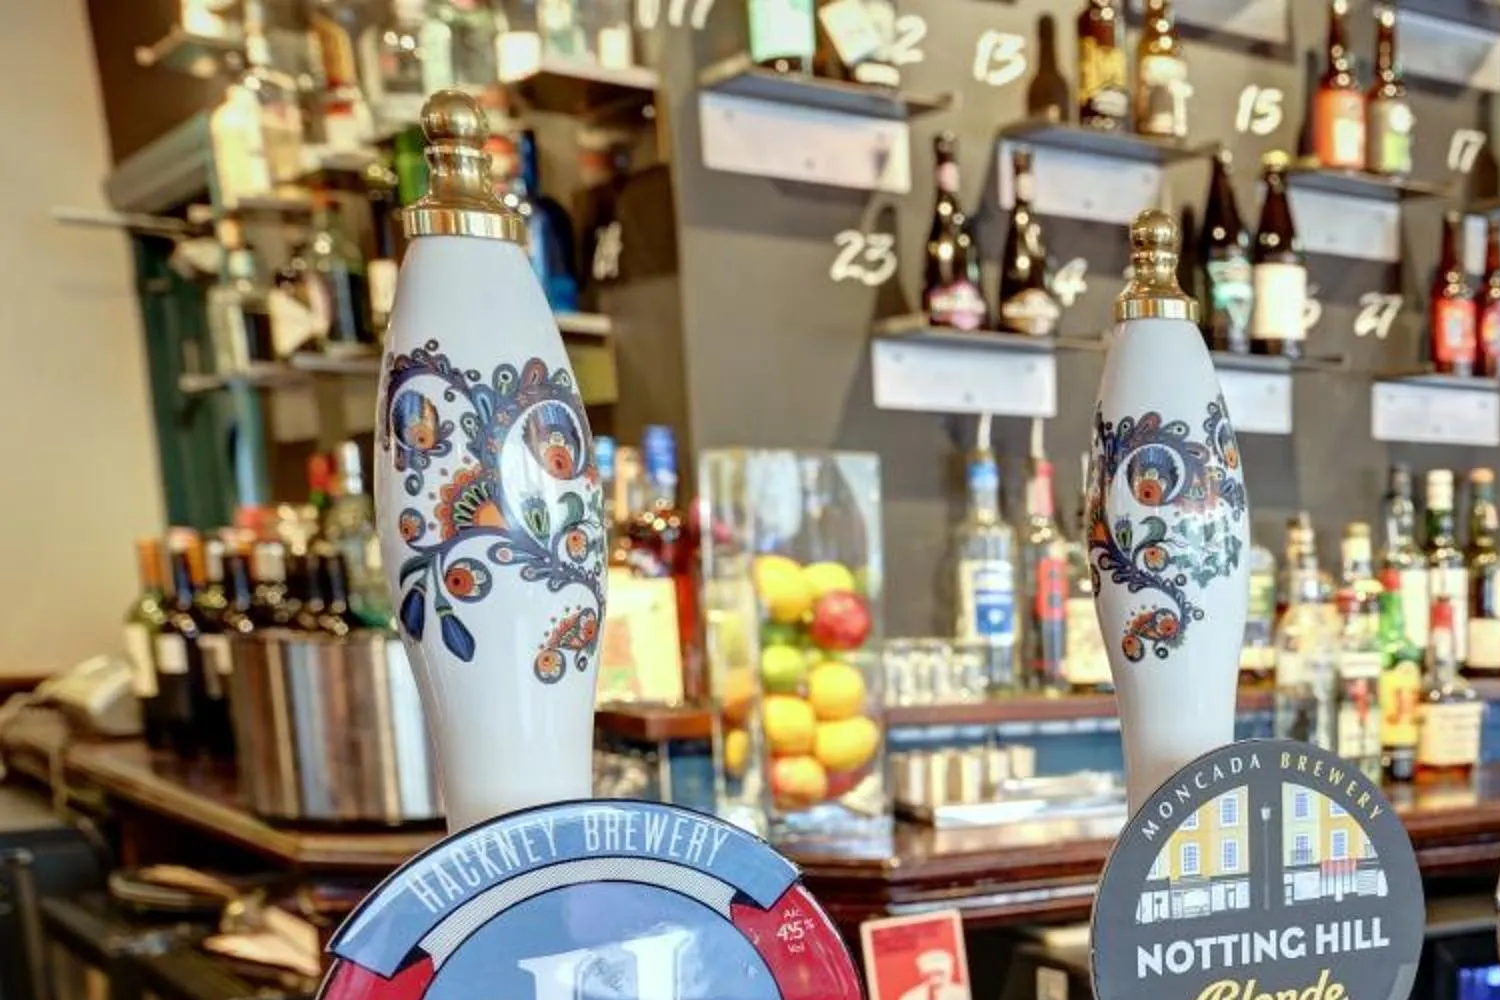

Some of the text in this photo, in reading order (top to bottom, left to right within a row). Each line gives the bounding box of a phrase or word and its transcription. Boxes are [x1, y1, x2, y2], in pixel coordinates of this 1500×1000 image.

[973, 30, 1027, 86] 13
[1235, 83, 1284, 135] 15
[1447, 128, 1487, 173] 17
[829, 229, 898, 286] 23
[1140, 751, 1385, 842] MONCADA BREWERY
[404, 810, 731, 914] HACKNEY BREWERY
[1137, 917, 1390, 979] NOTTING HILL
